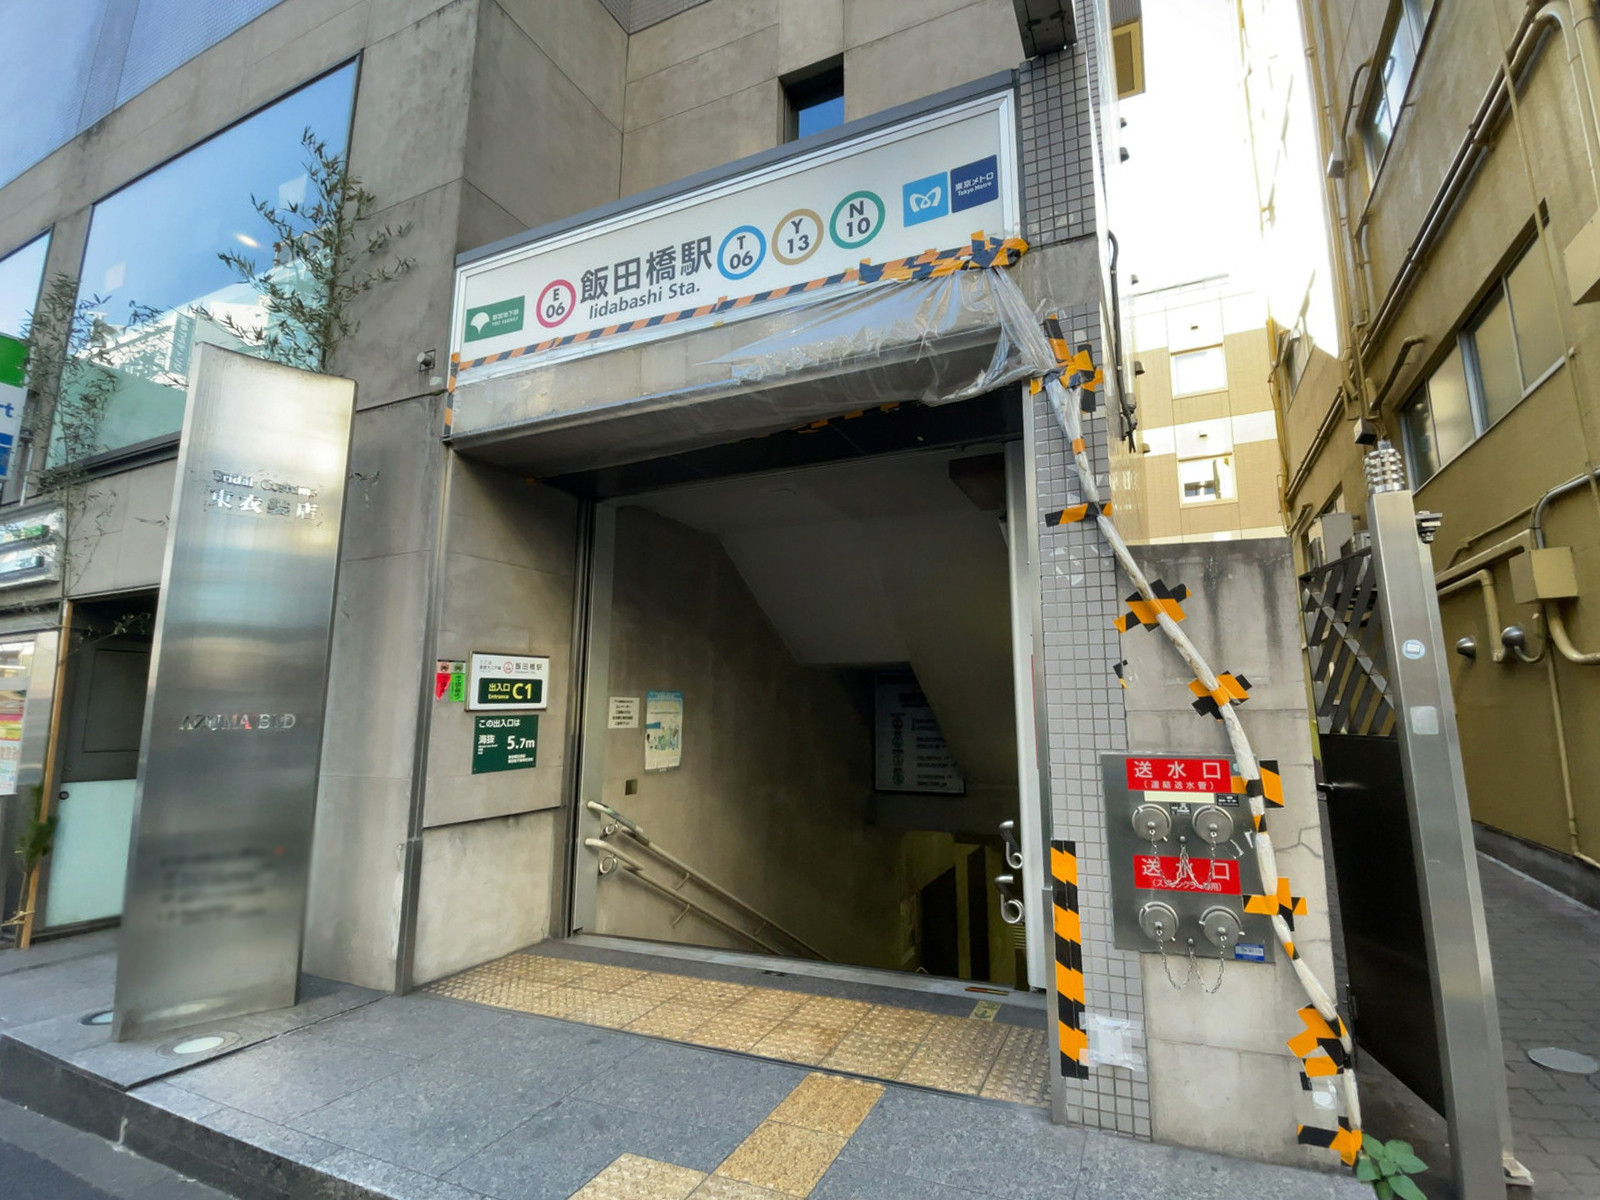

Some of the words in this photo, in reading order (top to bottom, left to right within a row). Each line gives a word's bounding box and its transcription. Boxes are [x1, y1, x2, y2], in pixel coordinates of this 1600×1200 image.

[955, 172, 994, 191] 東京メトロ
[957, 187, 974, 196] Tokyo
[974, 181, 992, 191] Metro
[850, 200, 864, 219] N
[791, 218, 804, 234] Y
[846, 217, 871, 238] 10
[736, 235, 746, 250] T
[787, 234, 810, 254] 13
[580, 235, 712, 304] 飯田橋駅
[729, 254, 753, 270] 06
[553, 288, 560, 302] E
[589, 286, 663, 319] Iidabashi
[668, 281, 700, 299] Sta.
[546, 303, 566, 319] 06
[213, 470, 254, 488] Bridal
[515, 662, 542, 671] 飯田橋駅
[488, 683, 511, 692] 出入口
[512, 682, 533, 700] C1
[179, 713, 252, 731] AZUMA
[479, 718, 521, 728] この出入口は
[478, 734, 496, 744] 海抜
[507, 735, 535, 750] 5.7m
[1134, 760, 1221, 779] 送水口
[1141, 857, 1230, 880] 送水口
